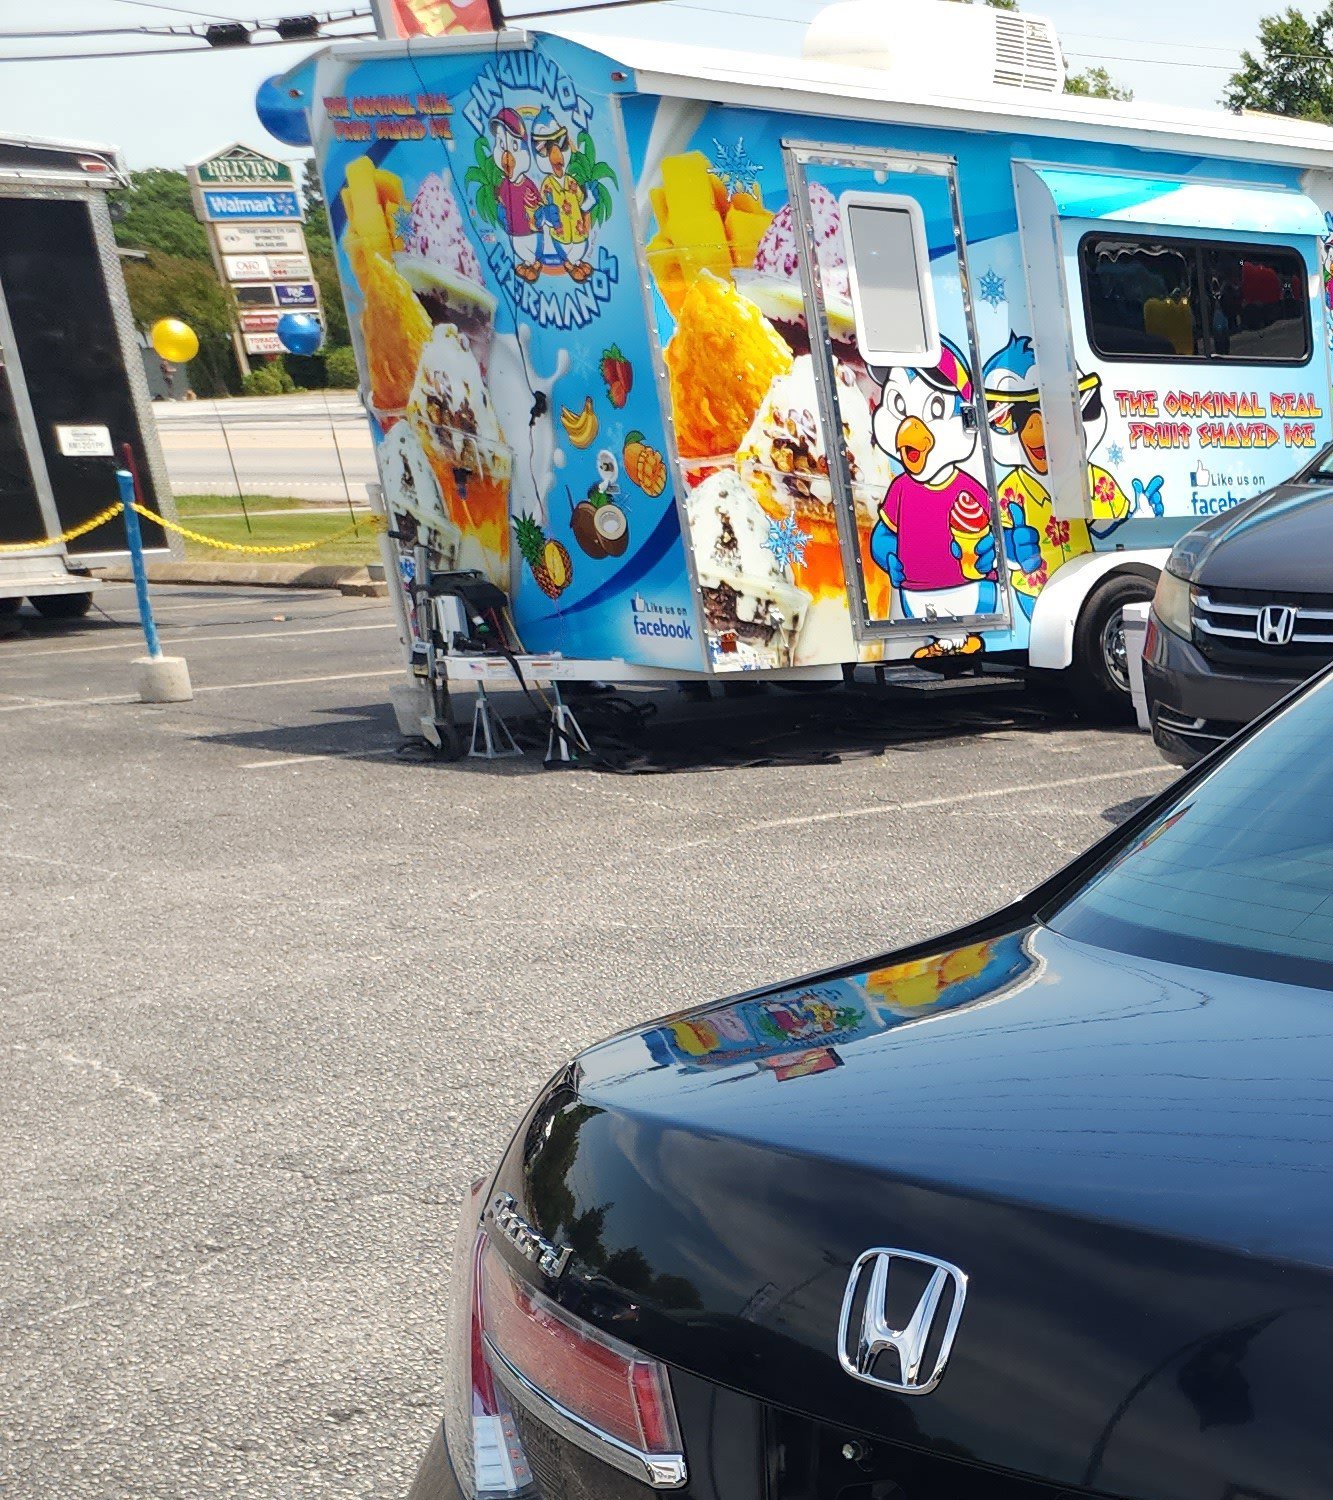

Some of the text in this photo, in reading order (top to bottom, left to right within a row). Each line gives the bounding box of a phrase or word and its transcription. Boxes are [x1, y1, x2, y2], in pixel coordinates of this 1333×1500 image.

[462, 50, 593, 136] PINGUINOS
[207, 161, 279, 176] HILLVIEW
[209, 196, 277, 212] Walmart
[488, 243, 618, 330] HERMANOS
[1113, 389, 1323, 419] THE ORIGINAL REAL
[1128, 422, 1317, 449] FRUIT SHAVED ICE
[1211, 474, 1266, 486] Like us on
[645, 602, 687, 616] Like us on
[633, 615, 693, 640] facebook
